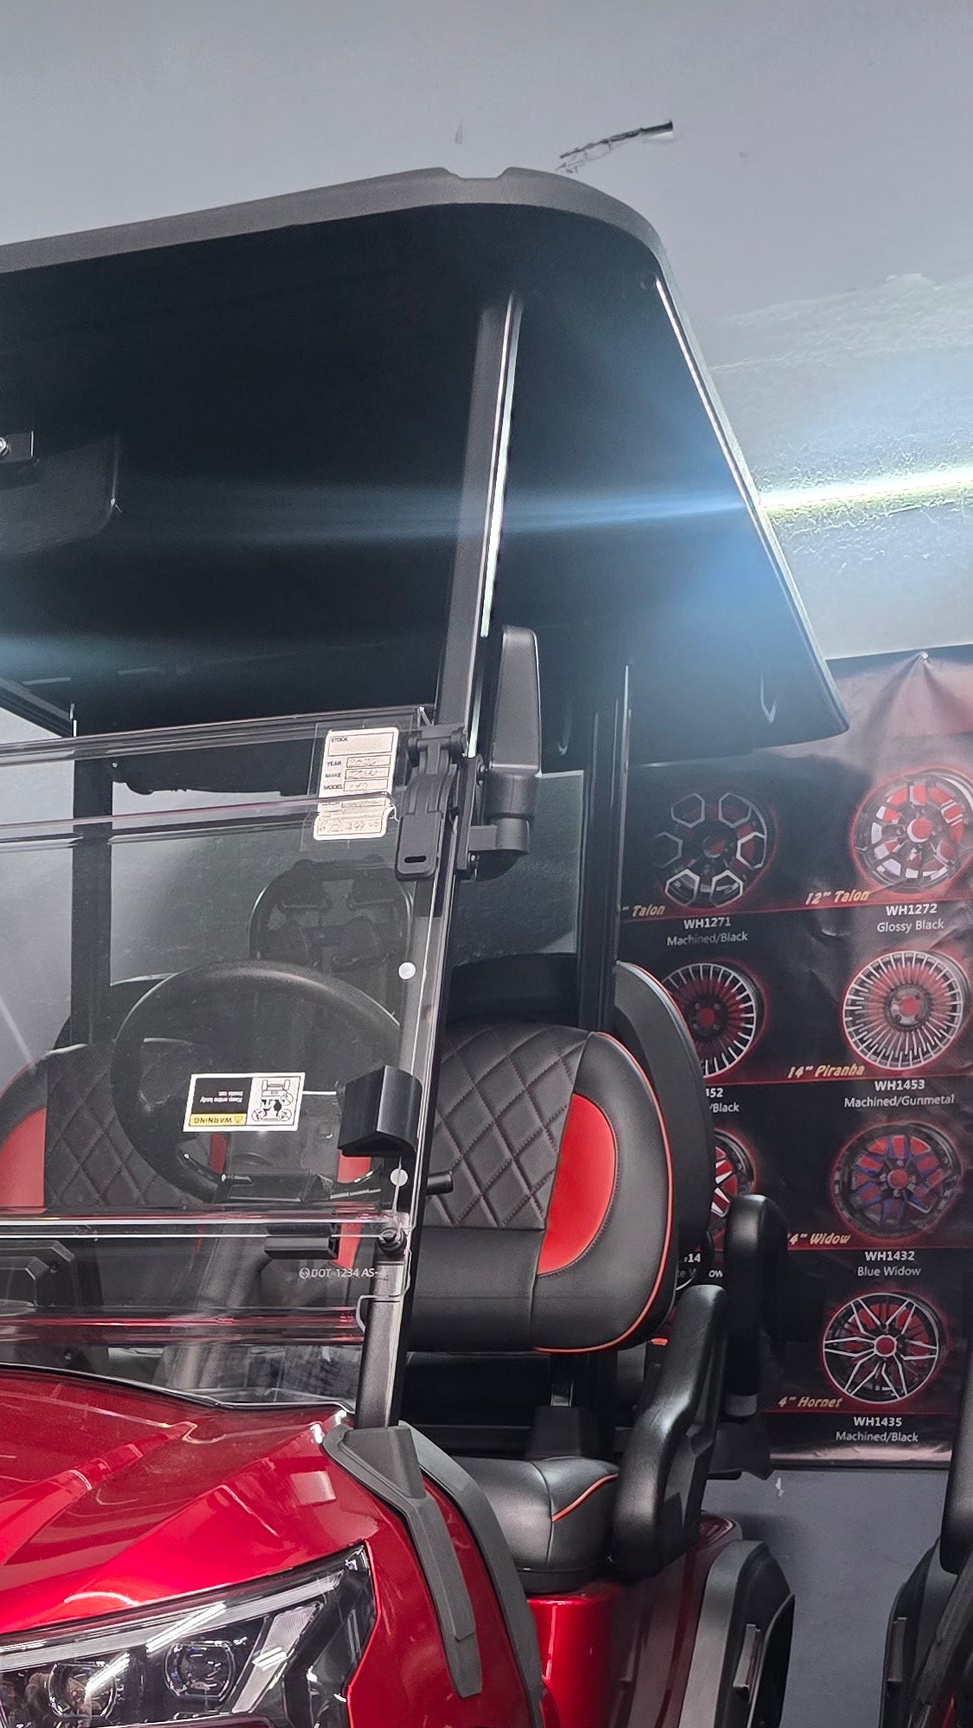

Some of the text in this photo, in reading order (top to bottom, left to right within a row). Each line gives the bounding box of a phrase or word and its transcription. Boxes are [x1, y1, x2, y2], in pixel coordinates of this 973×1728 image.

[833, 889, 871, 903] Talon
[632, 904, 666, 917] Talon
[885, 903, 938, 916] WH1272
[683, 917, 732, 930] WH1271
[876, 918, 945, 934] Glossy Black
[667, 931, 748, 947] Machined/Black
[814, 1063, 865, 1077] Piranha
[874, 1079, 925, 1092] WH1453
[844, 1094, 955, 1108] Machined/Gunmetal
[810, 1232, 852, 1245] Widow
[864, 1250, 915, 1262] WH1432
[857, 1265, 922, 1277] Blue Widow
[797, 1396, 843, 1408] Hornet
[853, 1416, 903, 1427] WH1435
[835, 1431, 919, 1443] Machined/Black
